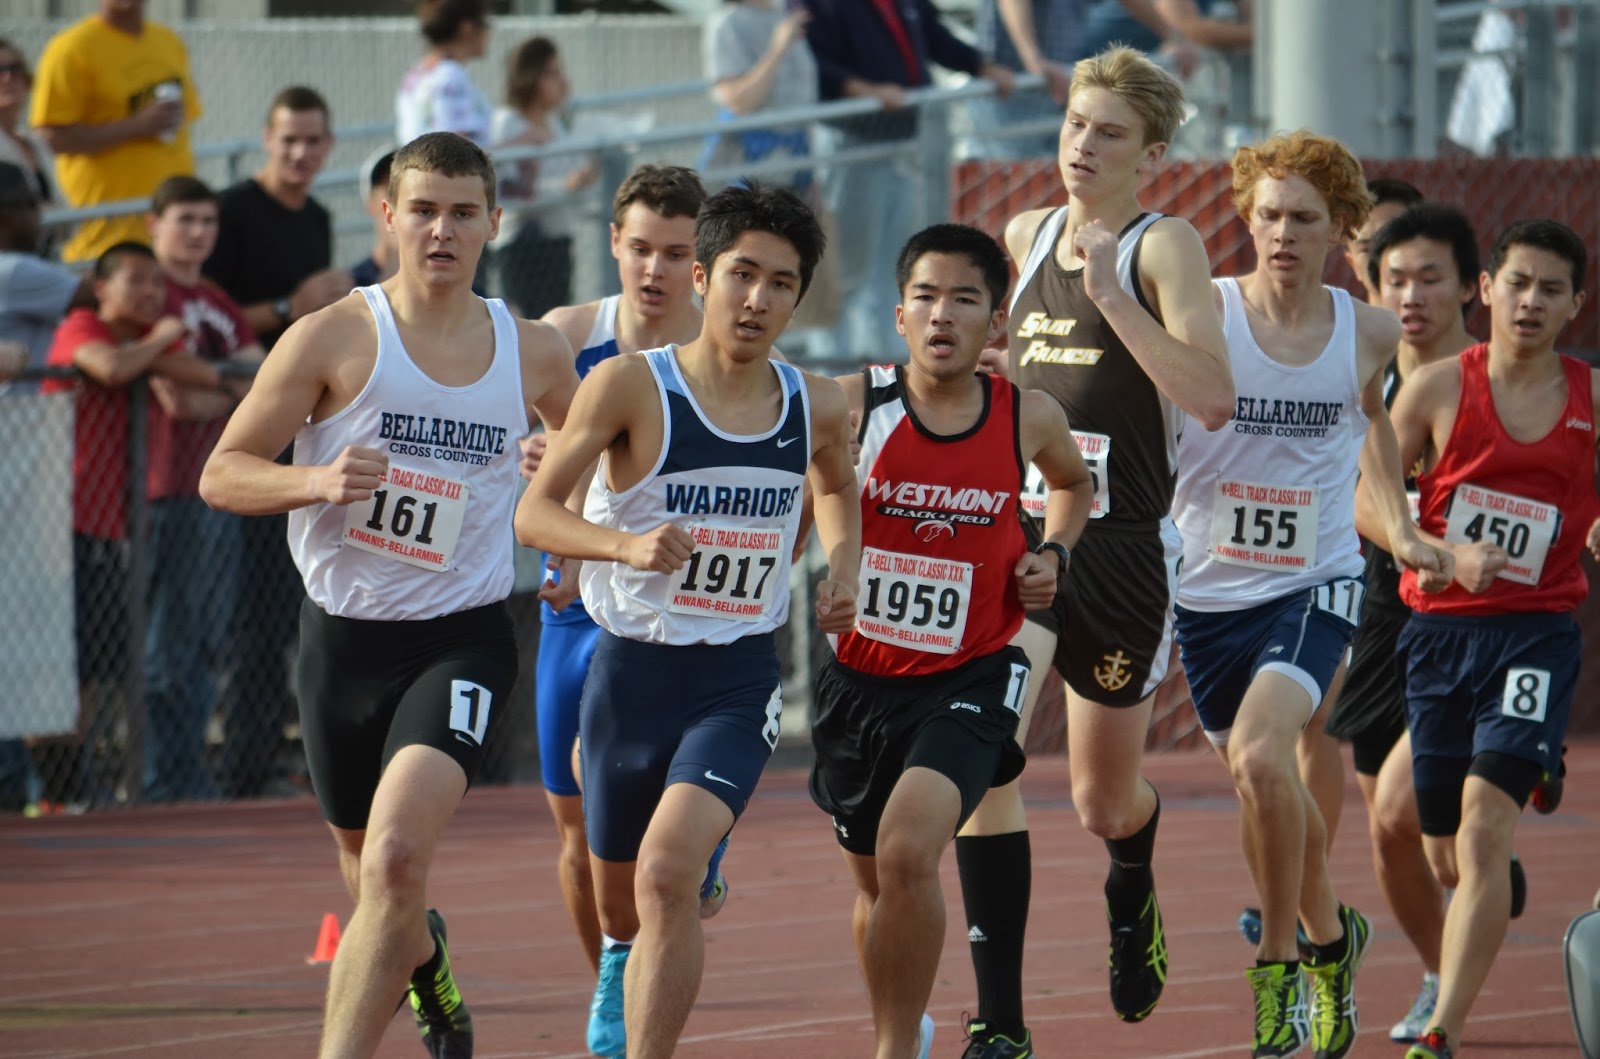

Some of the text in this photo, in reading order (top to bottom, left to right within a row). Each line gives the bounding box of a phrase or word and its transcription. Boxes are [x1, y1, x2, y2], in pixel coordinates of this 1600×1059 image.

[1231, 397, 1343, 426] ELLARMINE
[379, 411, 507, 455] BELLARMINE
[1235, 423, 1329, 438] CROSS COUNTRY
[389, 442, 492, 466] CROSS COUNTRY
[390, 467, 416, 489] TRACK
[414, 473, 446, 496] CLASSIC
[444, 481, 463, 501] XXX
[666, 483, 800, 517] WARRIORS
[868, 477, 1010, 515] WESTMONT
[1221, 482, 1313, 506] K-BELL TRACK CLASSIC XXX
[366, 490, 438, 545] 161
[884, 506, 936, 519] TRACK
[950, 513, 991, 525] FIELD
[1231, 506, 1298, 550] 155
[348, 528, 445, 565] KIWANIS-BELLARMINE
[690, 525, 780, 550] K-BELL TRACK CLASSIC XXX
[1464, 513, 1530, 559] 450
[867, 552, 965, 583] K-BELL TRACK CLASSIC XXX
[1216, 544, 1306, 567] KIWANIS-BELLARMINE
[680, 551, 776, 600] 1917
[863, 577, 960, 630] 1959
[858, 619, 954, 648] KIWANIS-BELLARMINE
[1015, 668, 1027, 710] 1
[1512, 673, 1540, 717] 8
[460, 686, 481, 735] 1
[960, 702, 982, 714] asics
